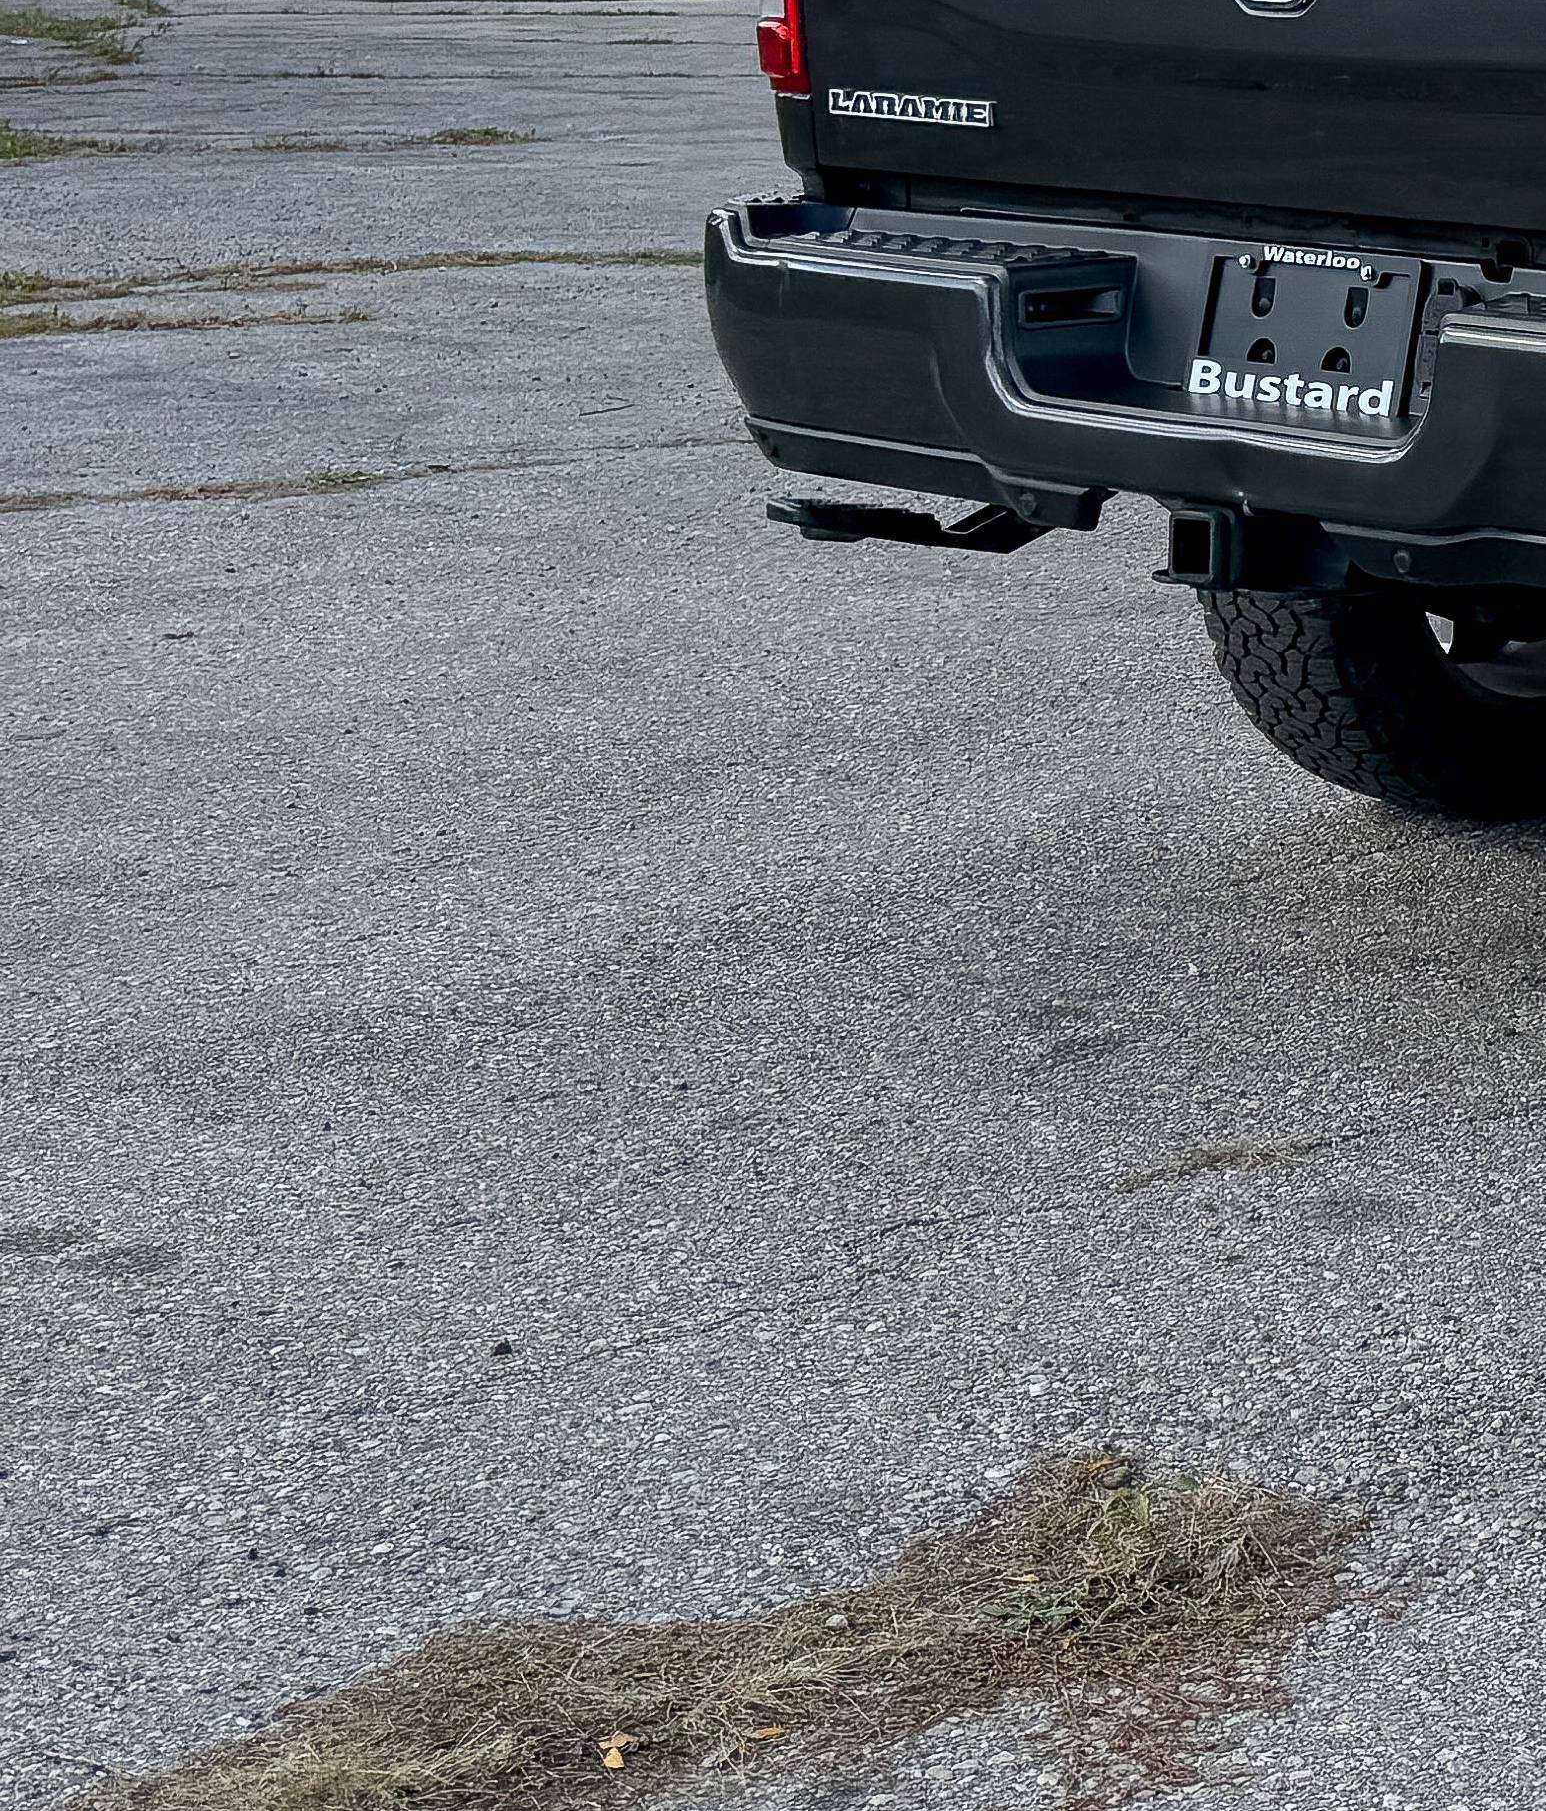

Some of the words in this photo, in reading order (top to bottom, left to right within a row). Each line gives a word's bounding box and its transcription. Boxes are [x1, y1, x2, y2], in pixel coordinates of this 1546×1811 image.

[828, 89, 995, 128] LARAMIE
[1263, 245, 1361, 269] Waterloo
[1187, 358, 1394, 418] Bustard
